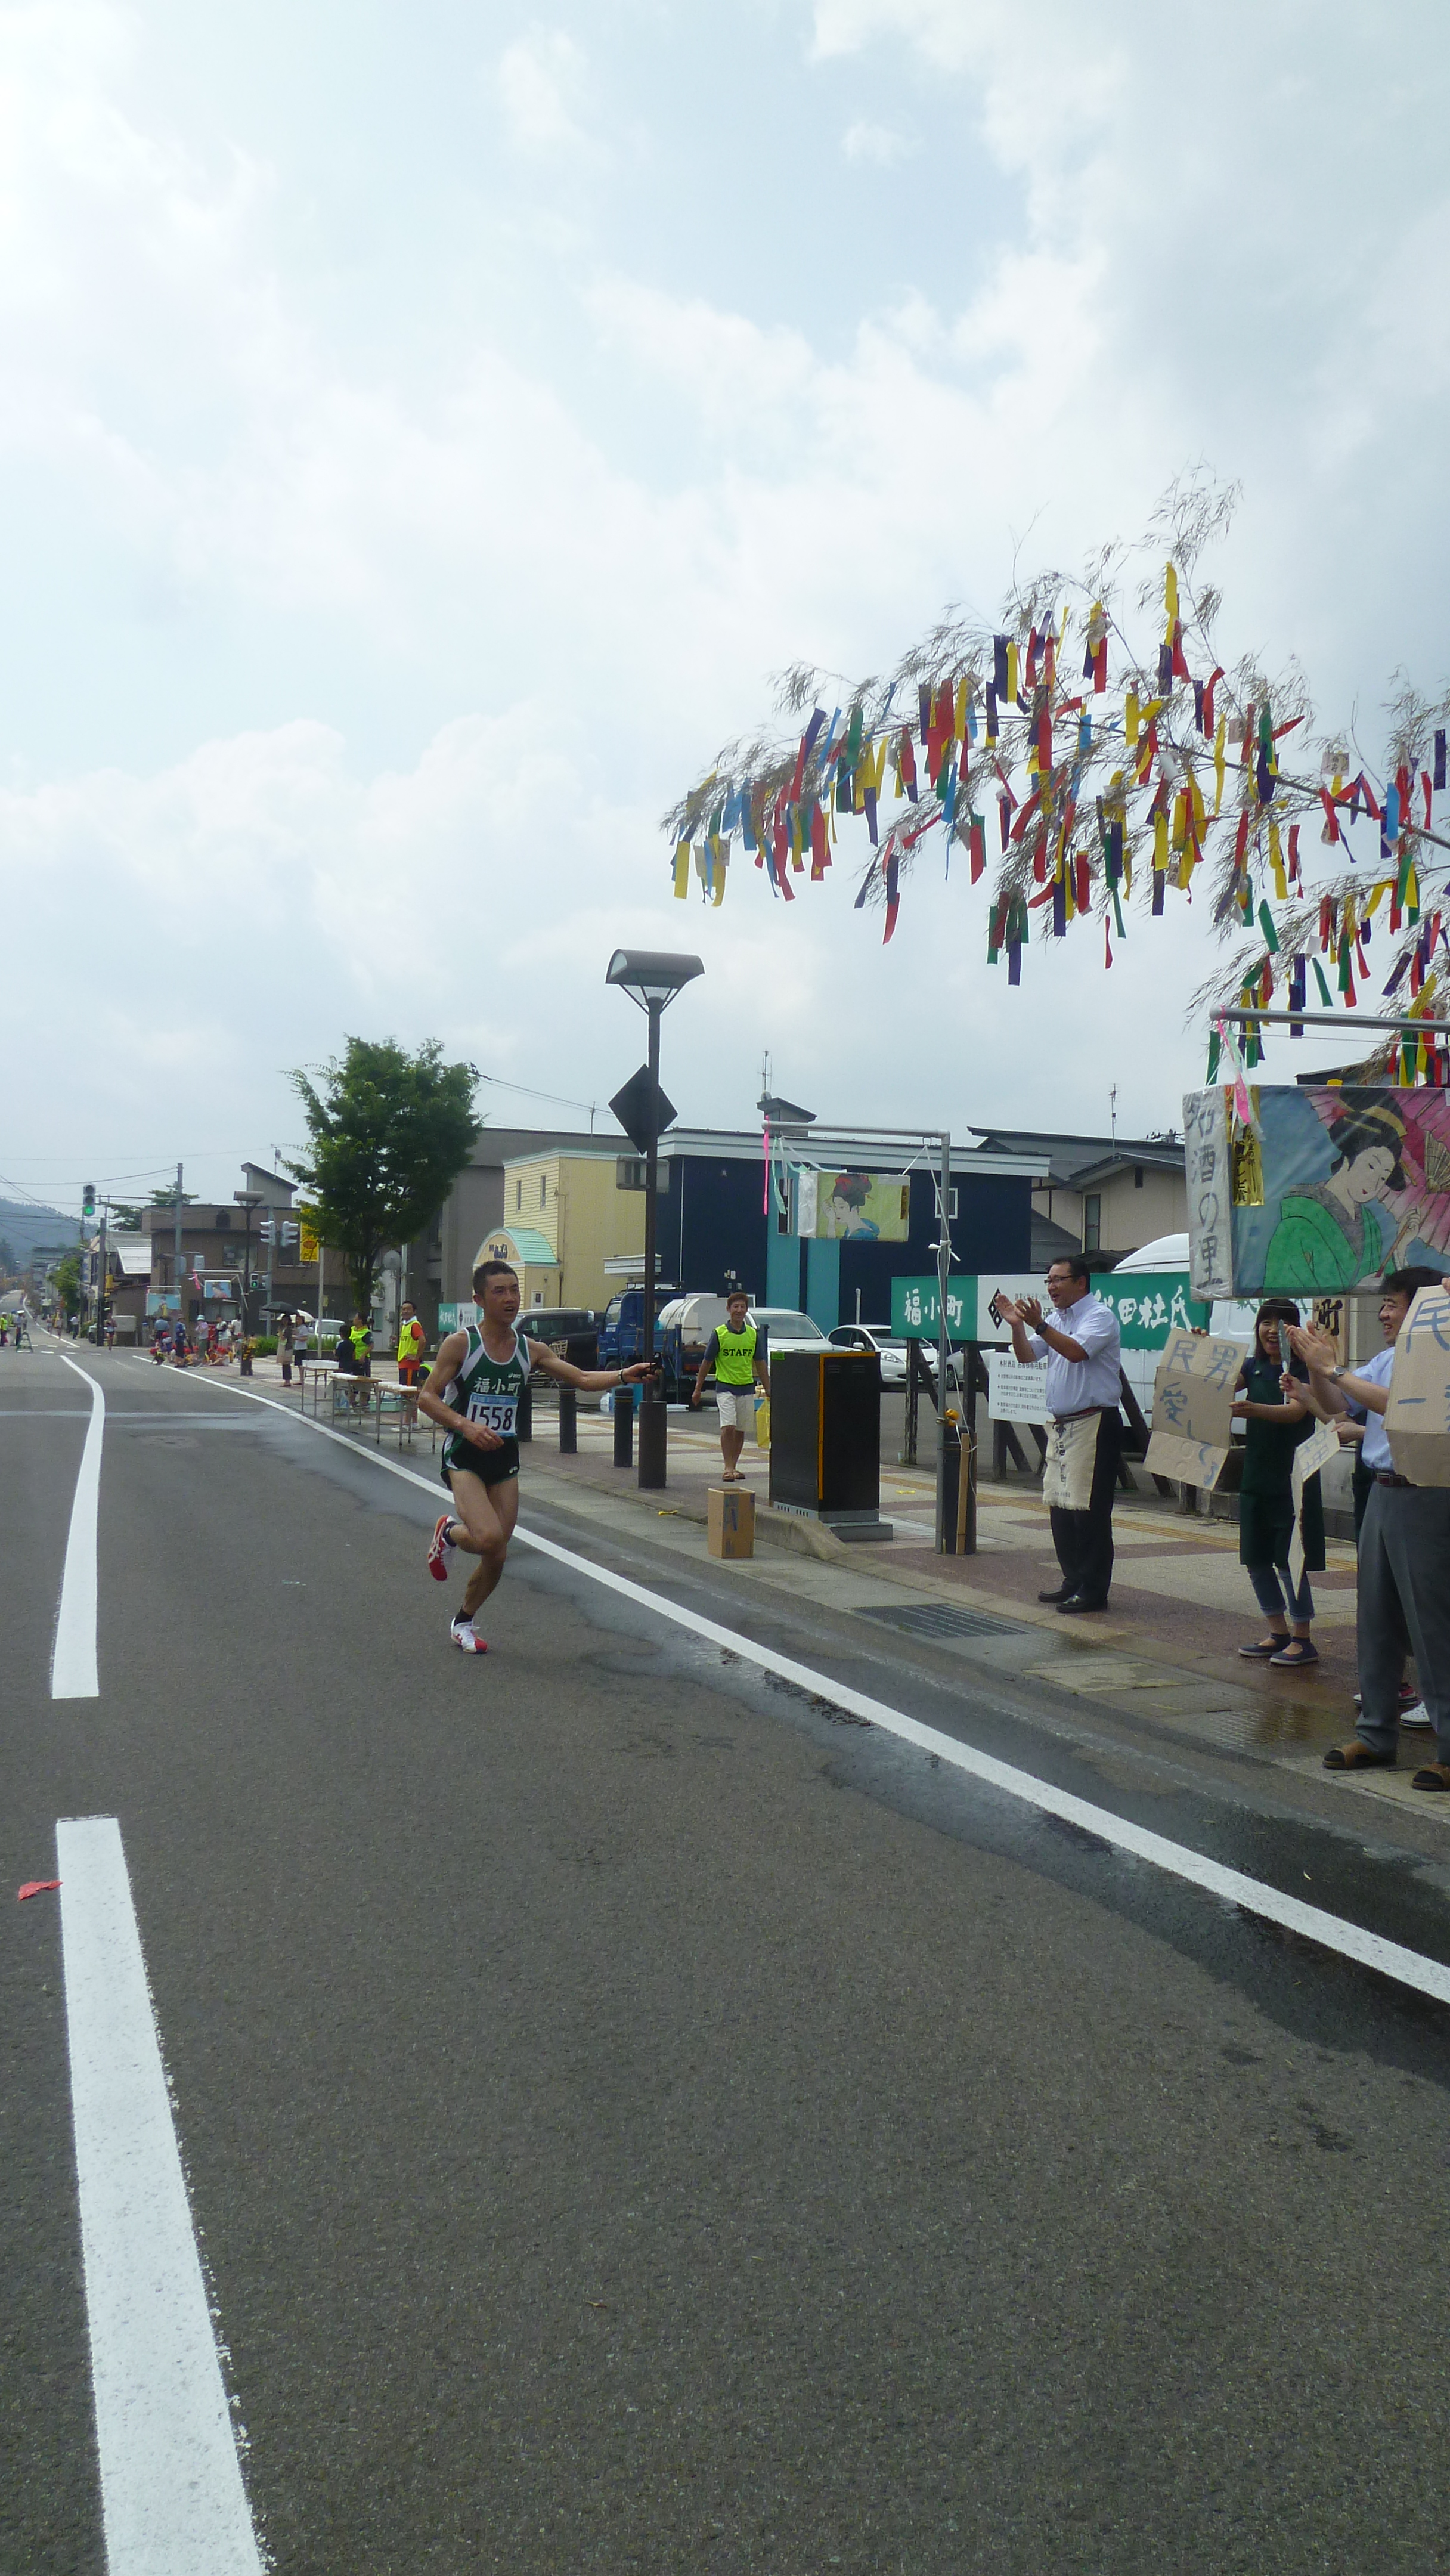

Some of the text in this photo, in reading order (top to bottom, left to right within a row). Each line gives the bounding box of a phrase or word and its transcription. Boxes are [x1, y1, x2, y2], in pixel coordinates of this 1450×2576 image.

[904, 1288, 963, 1327] 福小町
[723, 1348, 752, 1357] STAFF
[473, 1377, 521, 1397] 福小町
[470, 1404, 513, 1431] 1558
